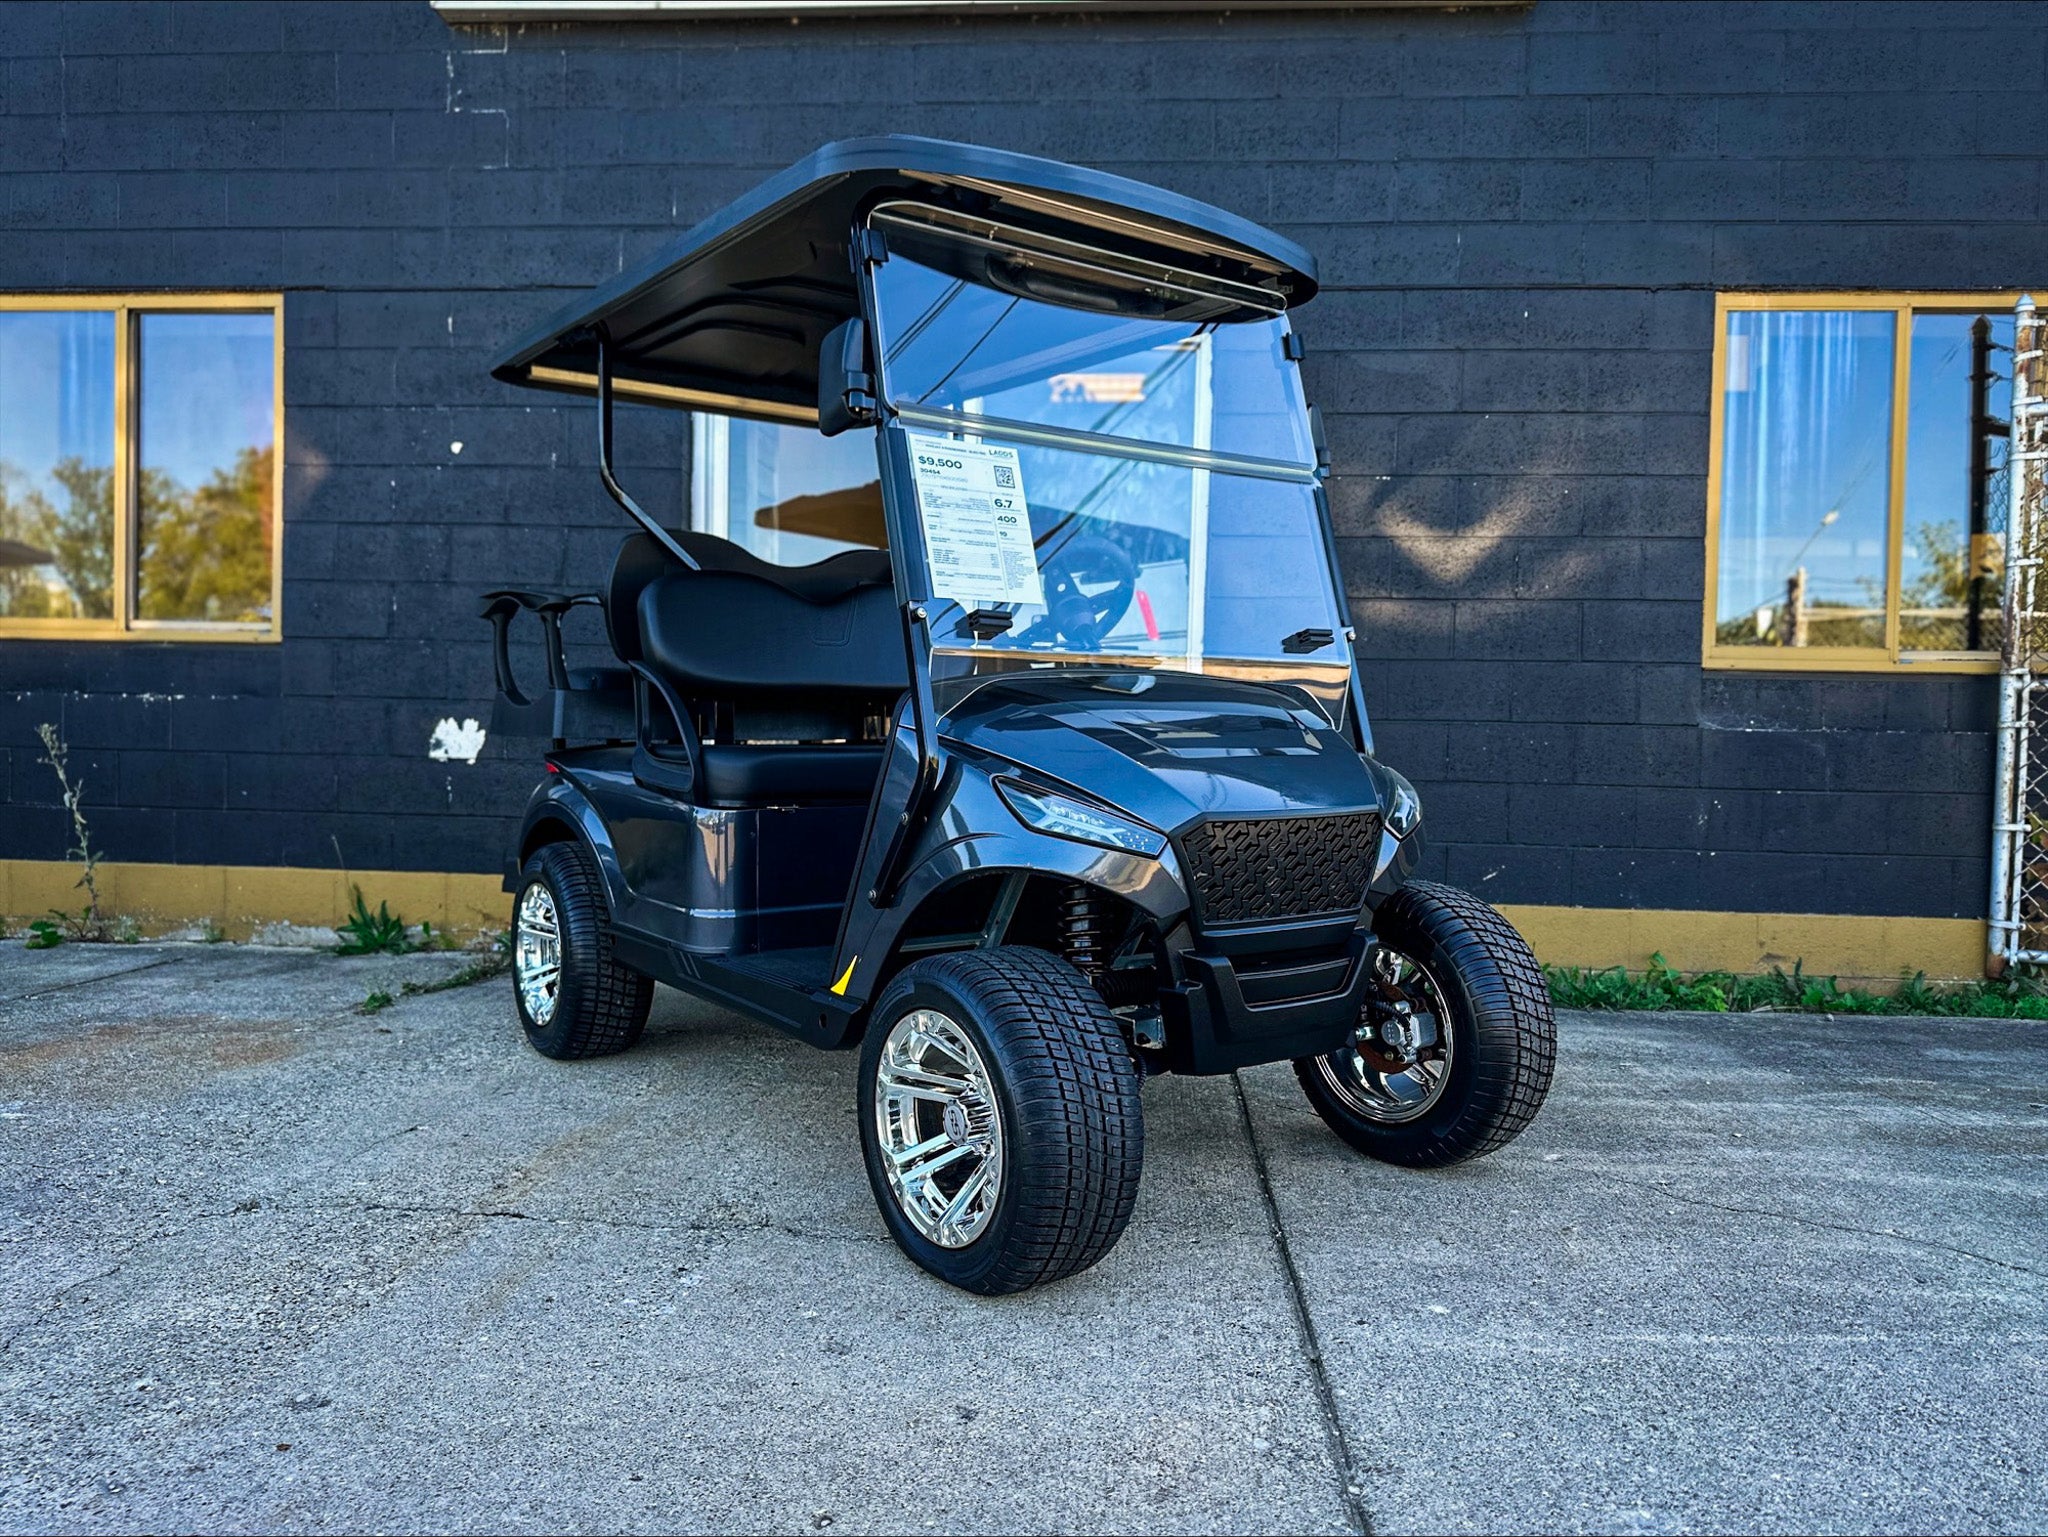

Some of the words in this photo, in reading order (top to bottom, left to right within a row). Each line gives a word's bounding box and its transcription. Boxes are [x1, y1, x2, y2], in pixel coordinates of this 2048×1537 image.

[918, 455, 963, 469] $9,500
[994, 498, 1013, 508] 6.7
[997, 515, 1017, 524] 400
